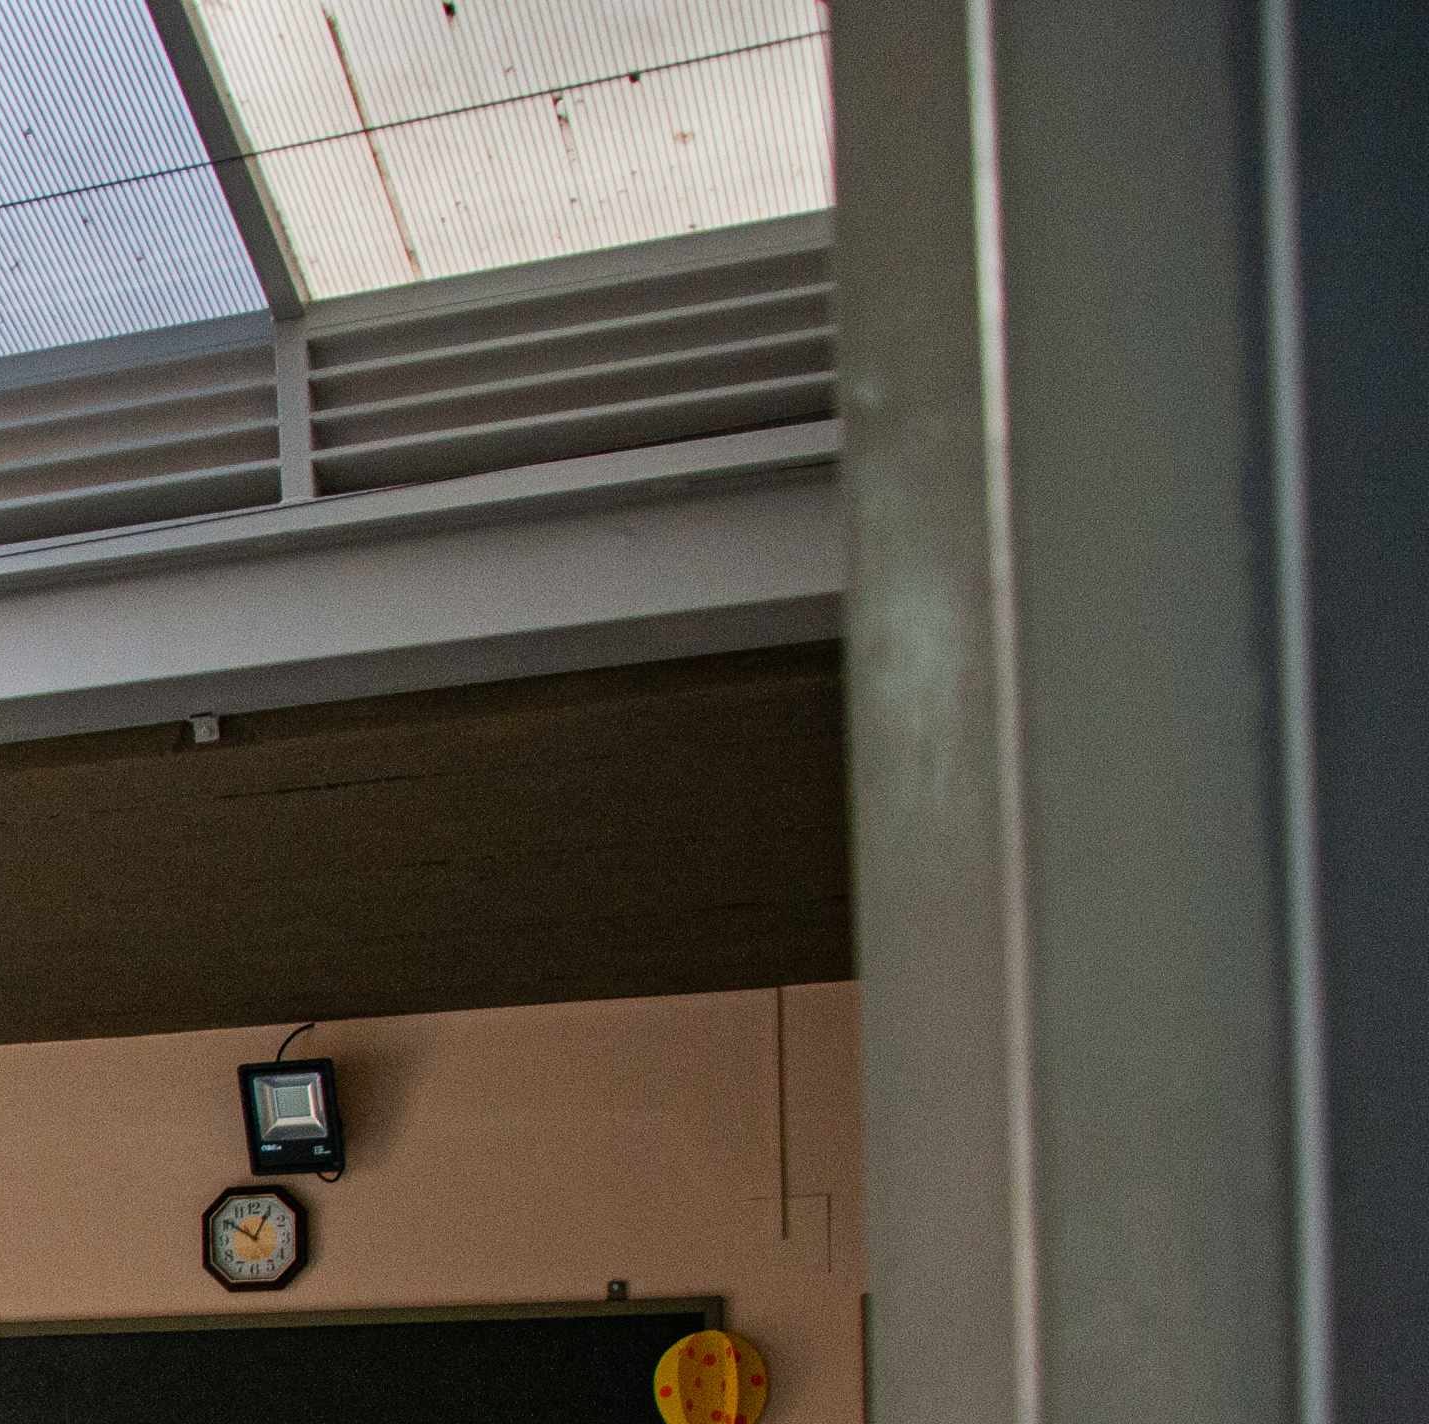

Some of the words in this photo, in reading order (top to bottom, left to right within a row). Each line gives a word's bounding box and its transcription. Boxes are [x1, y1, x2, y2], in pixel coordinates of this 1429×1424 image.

[248, 1202, 260, 1214] 12
[276, 1214, 285, 1227] 2
[281, 1231, 291, 1244] 3
[224, 1248, 234, 1262] 8
[237, 1260, 245, 1272] 7
[250, 1263, 259, 1274] 6
[266, 1259, 275, 1271] 5
